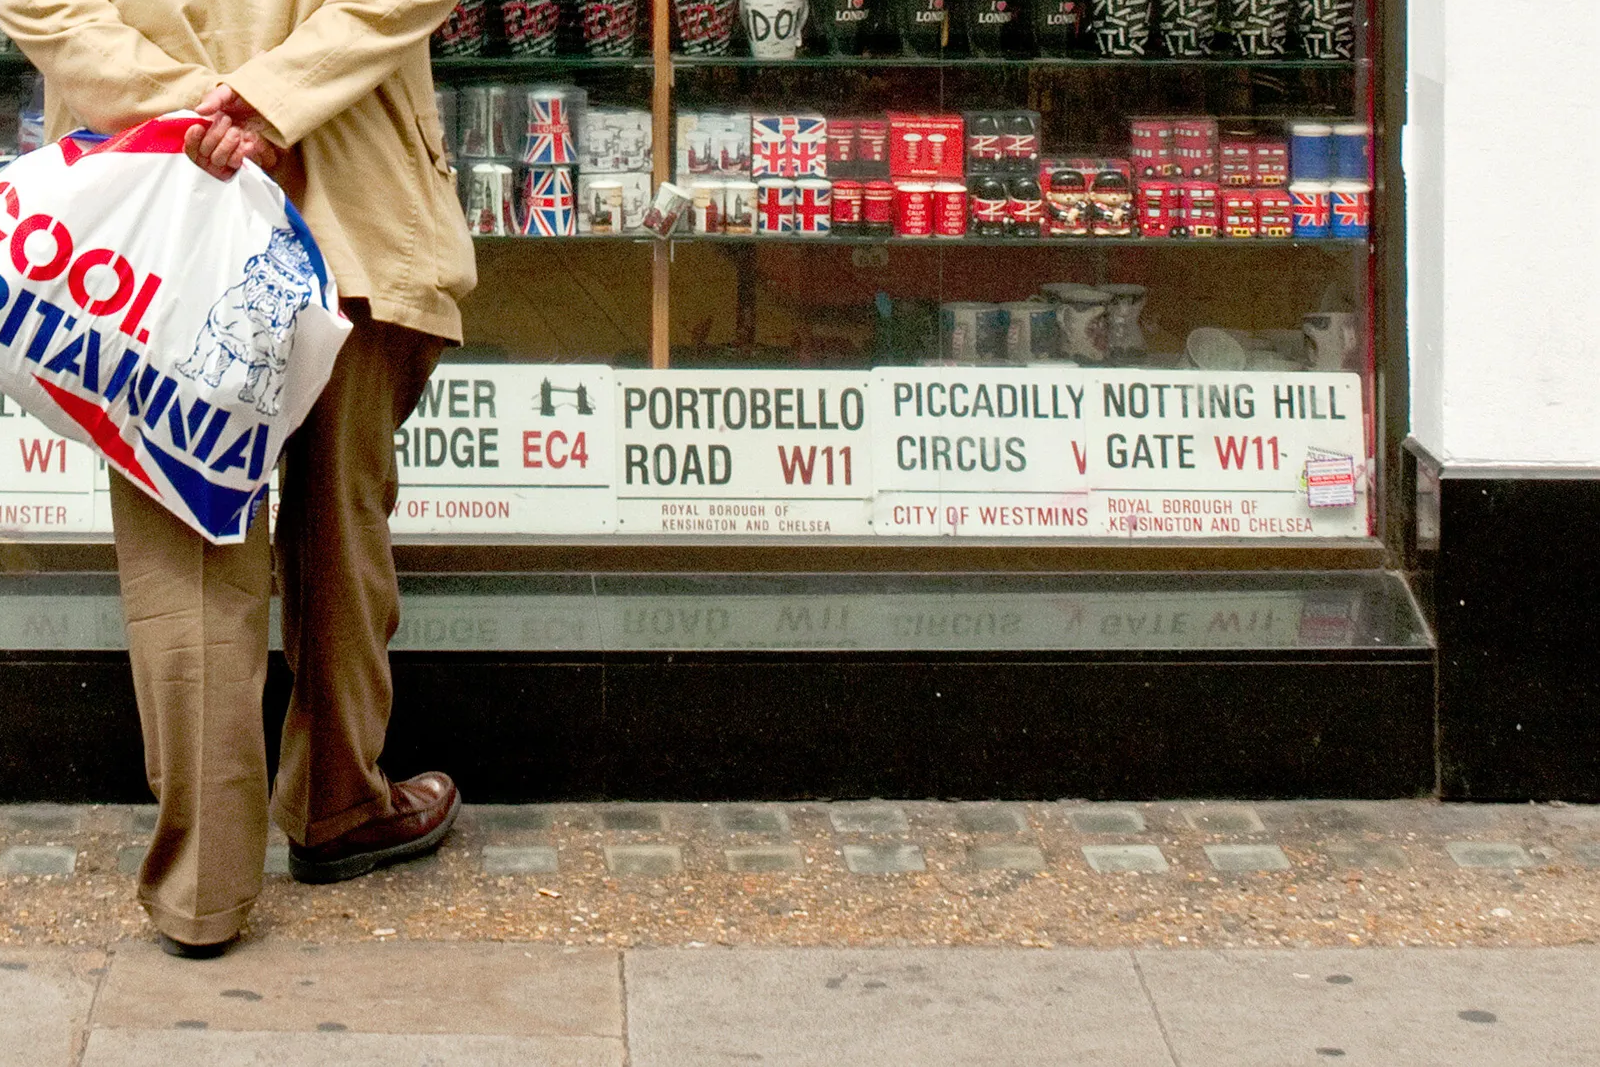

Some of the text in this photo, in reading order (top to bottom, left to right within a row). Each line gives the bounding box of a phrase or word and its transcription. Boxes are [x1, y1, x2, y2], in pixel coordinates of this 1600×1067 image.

[423, 380, 497, 419] WER
[624, 386, 864, 431] PORTOBELLO
[893, 382, 1085, 420] PICCADILLY
[1103, 382, 1346, 420] NOTTING HILL
[19, 438, 67, 474] W1
[395, 427, 589, 469] RIDGE EC4
[625, 444, 852, 486] ROAD W11
[899, 435, 1027, 473] CIRCUS
[1106, 434, 1196, 470] GATE
[1214, 435, 1280, 471] W11
[407, 501, 510, 519] OF LONDON
[661, 504, 789, 517] ROYAL BOROUGH OF
[893, 505, 1088, 527] CITY OF WESTMINS
[1108, 497, 1259, 516] ROYAL BOROUGH OF
[1109, 515, 1313, 533] KENSINGTON AND CHELSEA
[661, 519, 831, 533] KENSINGTON AND CHELSEA
